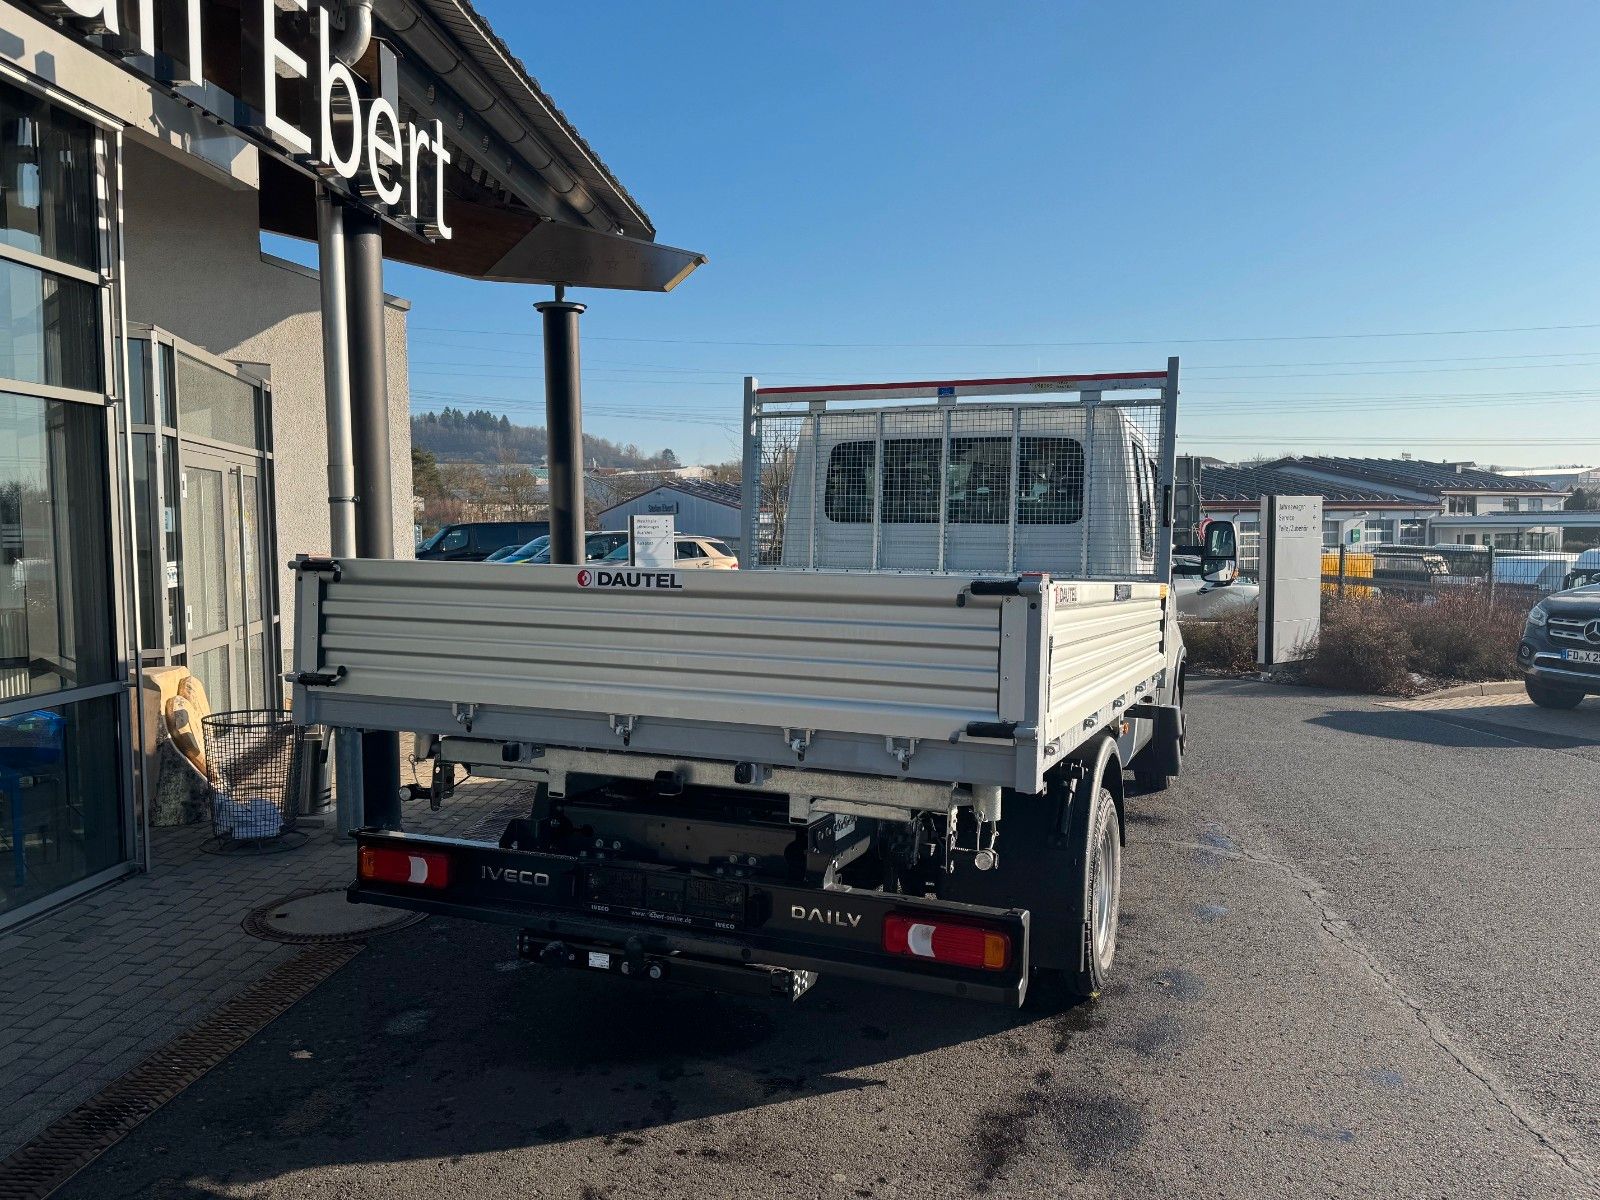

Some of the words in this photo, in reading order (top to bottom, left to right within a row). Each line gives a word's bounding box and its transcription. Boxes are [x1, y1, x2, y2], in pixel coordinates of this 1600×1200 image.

[264, 0, 452, 240] Ebert
[597, 571, 683, 589] DAUTEL
[1568, 650, 1579, 660] FD
[481, 865, 549, 886] IVECO
[591, 904, 609, 912] IVECO
[791, 904, 862, 928] DAILY
[715, 922, 735, 930] IVECO
